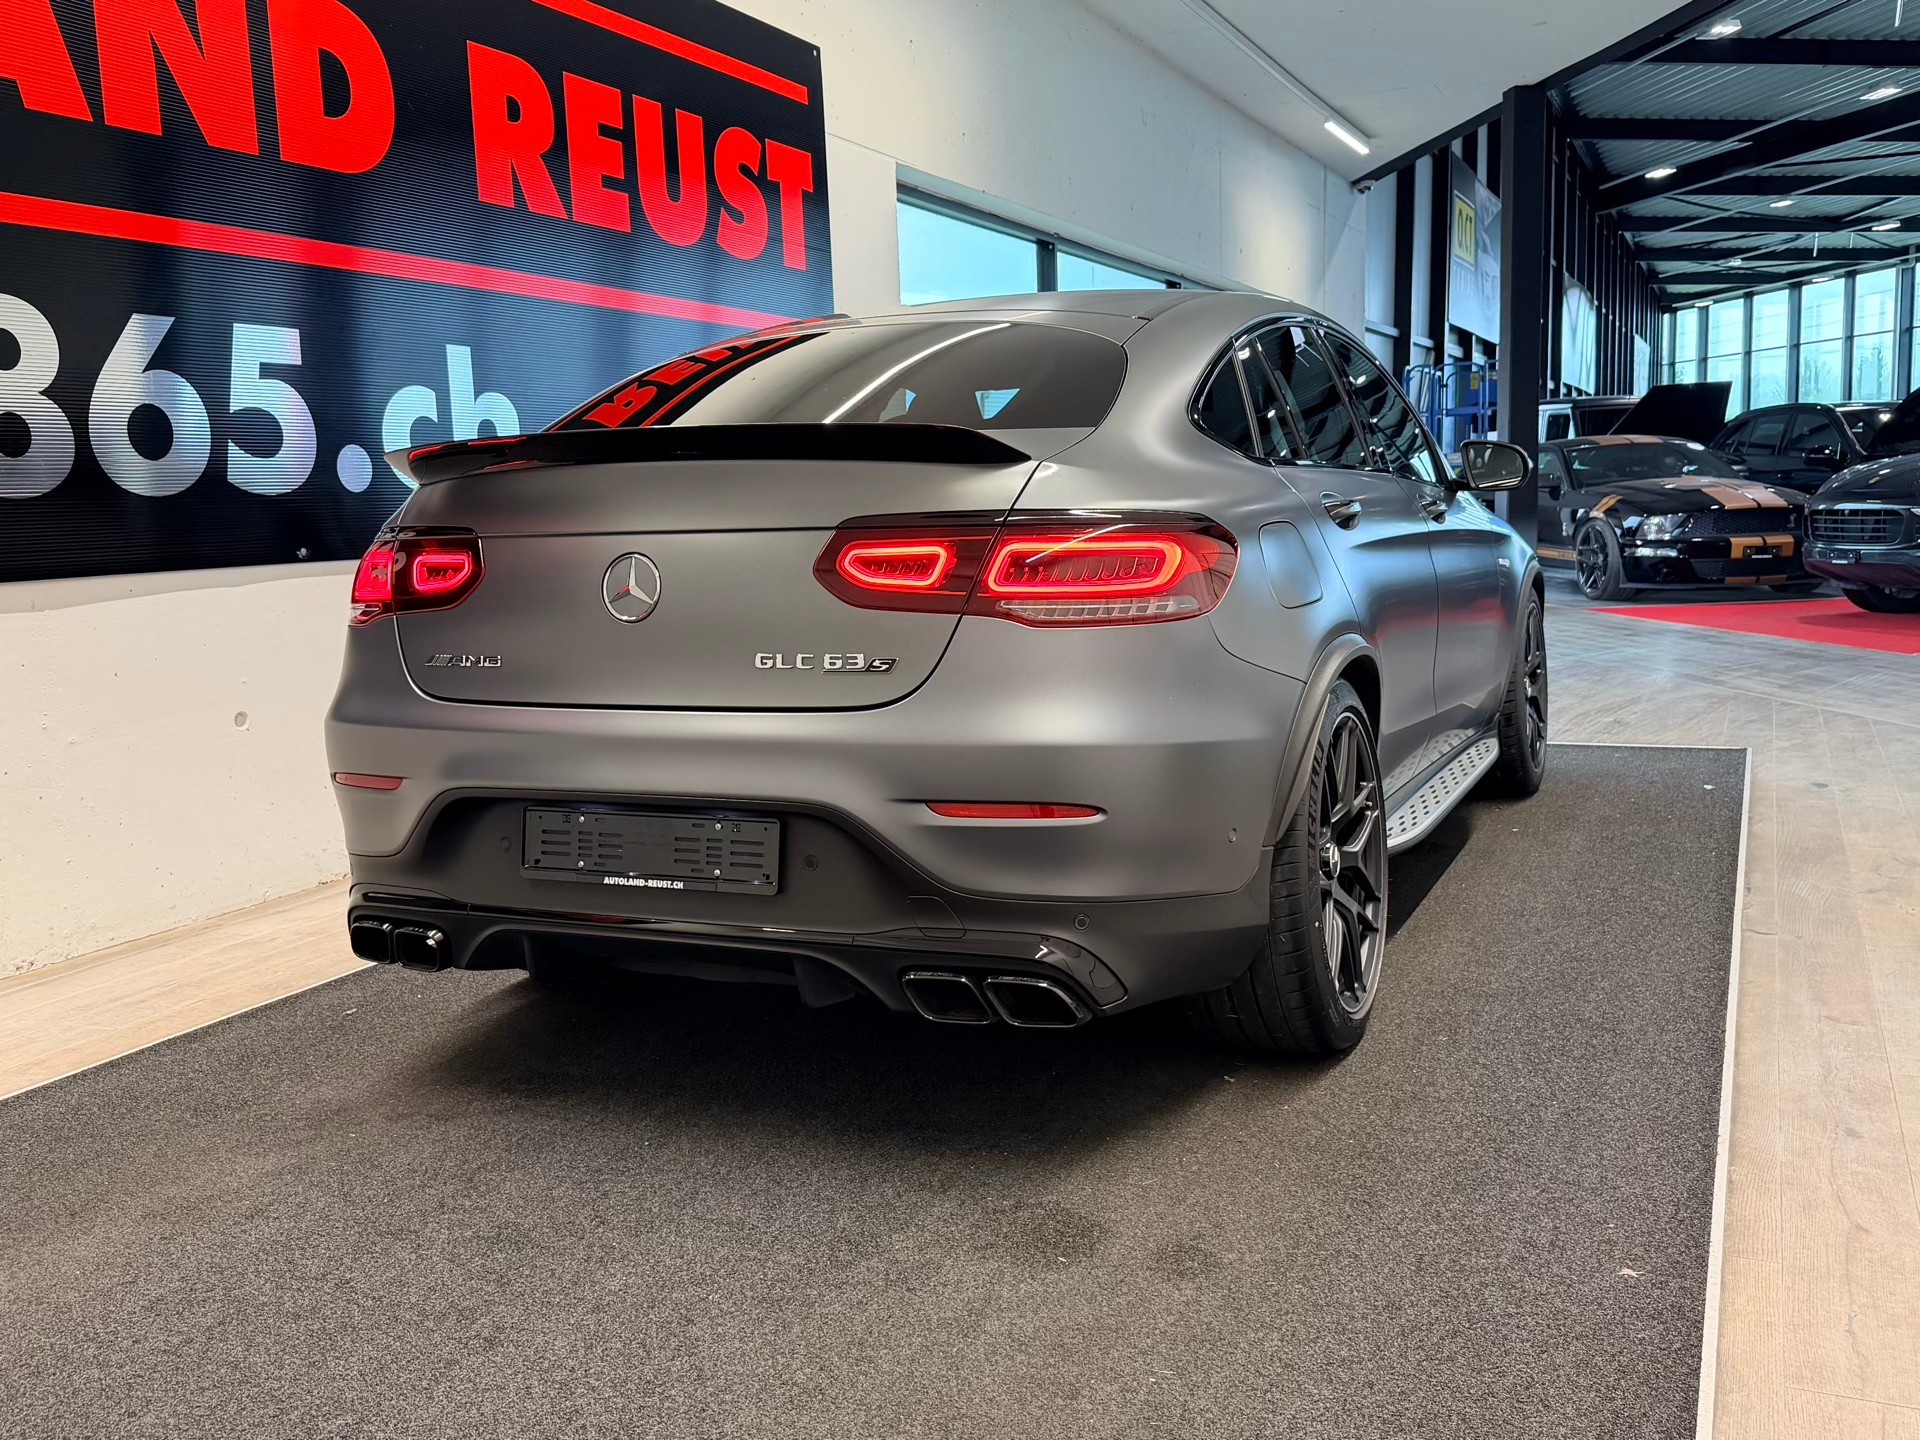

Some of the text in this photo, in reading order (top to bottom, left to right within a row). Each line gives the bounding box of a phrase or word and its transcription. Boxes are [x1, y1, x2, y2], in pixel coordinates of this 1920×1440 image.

[466, 40, 814, 271] REUST
[448, 654, 501, 667] AMG
[754, 652, 815, 669] GLC
[1308, 742, 1325, 871] MICHELIN
[603, 876, 684, 889] AUTOLAND-REUST.CH
